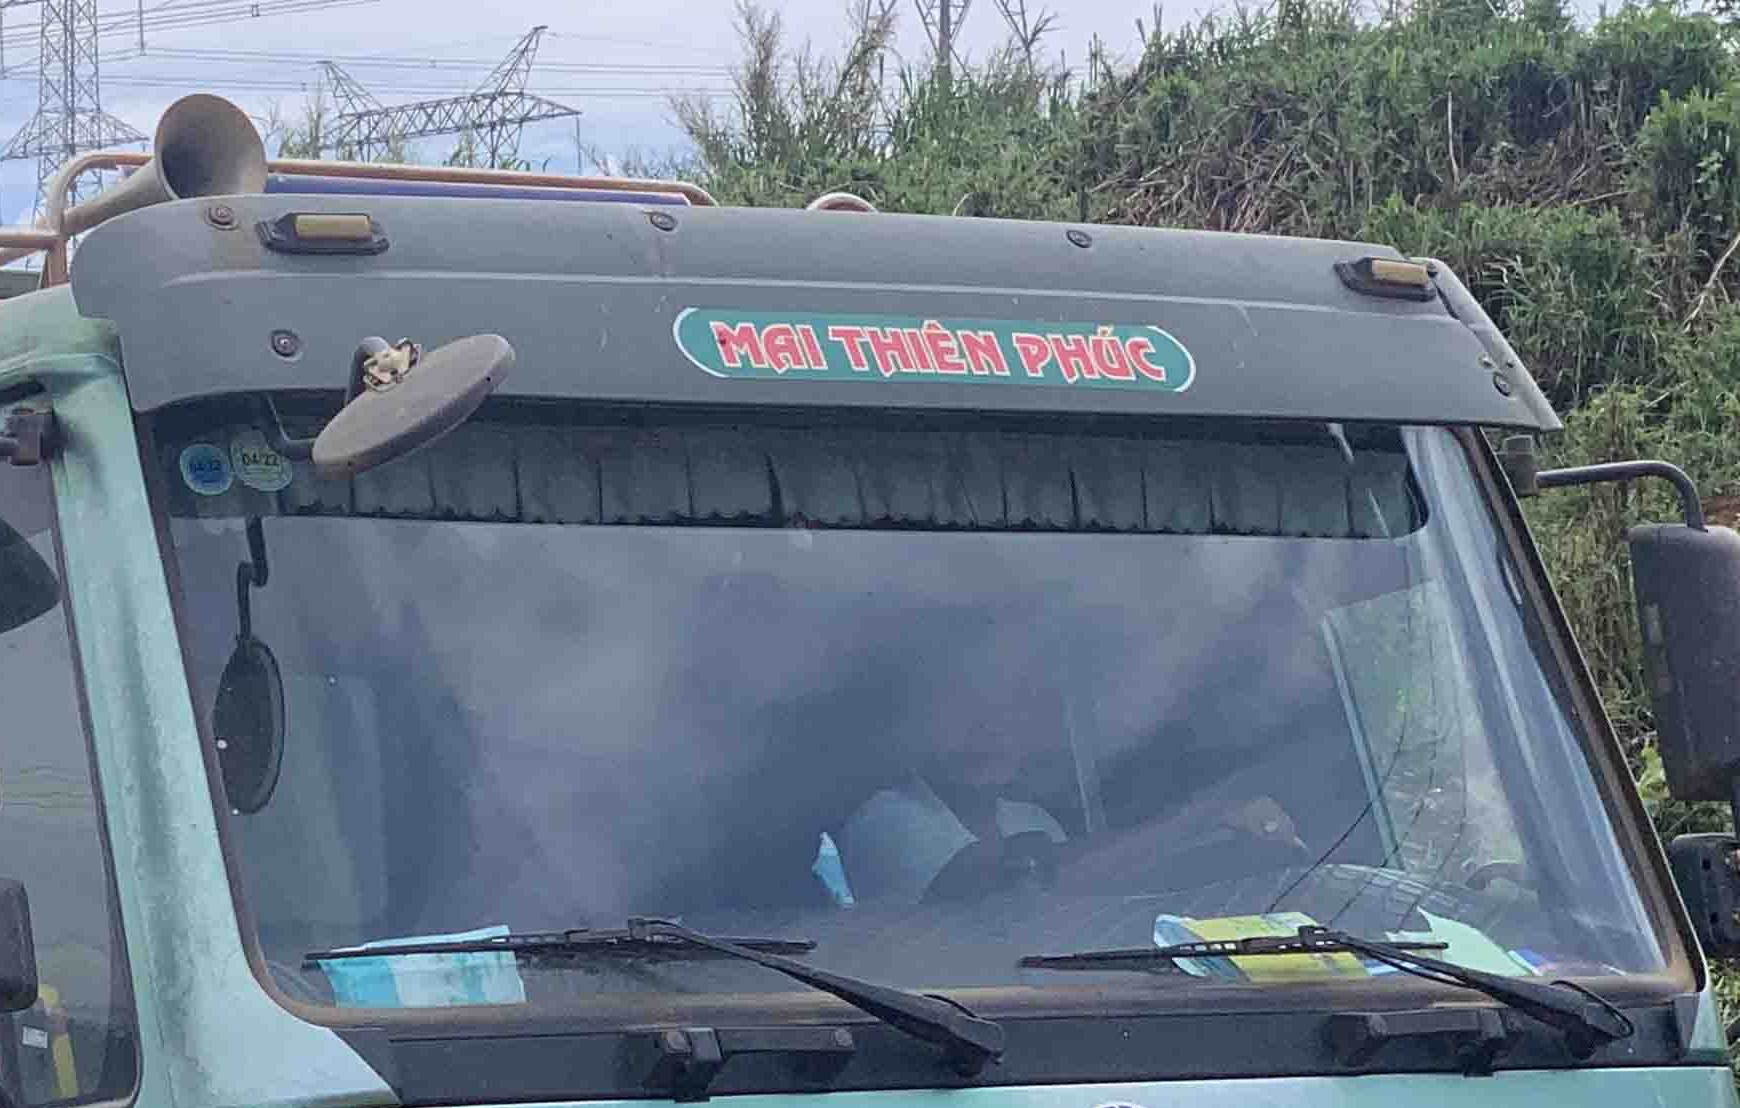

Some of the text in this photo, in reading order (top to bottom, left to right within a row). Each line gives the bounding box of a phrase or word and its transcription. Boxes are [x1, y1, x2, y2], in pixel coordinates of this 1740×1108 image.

[710, 318, 1166, 384] MAI THIÊN PHÚC
